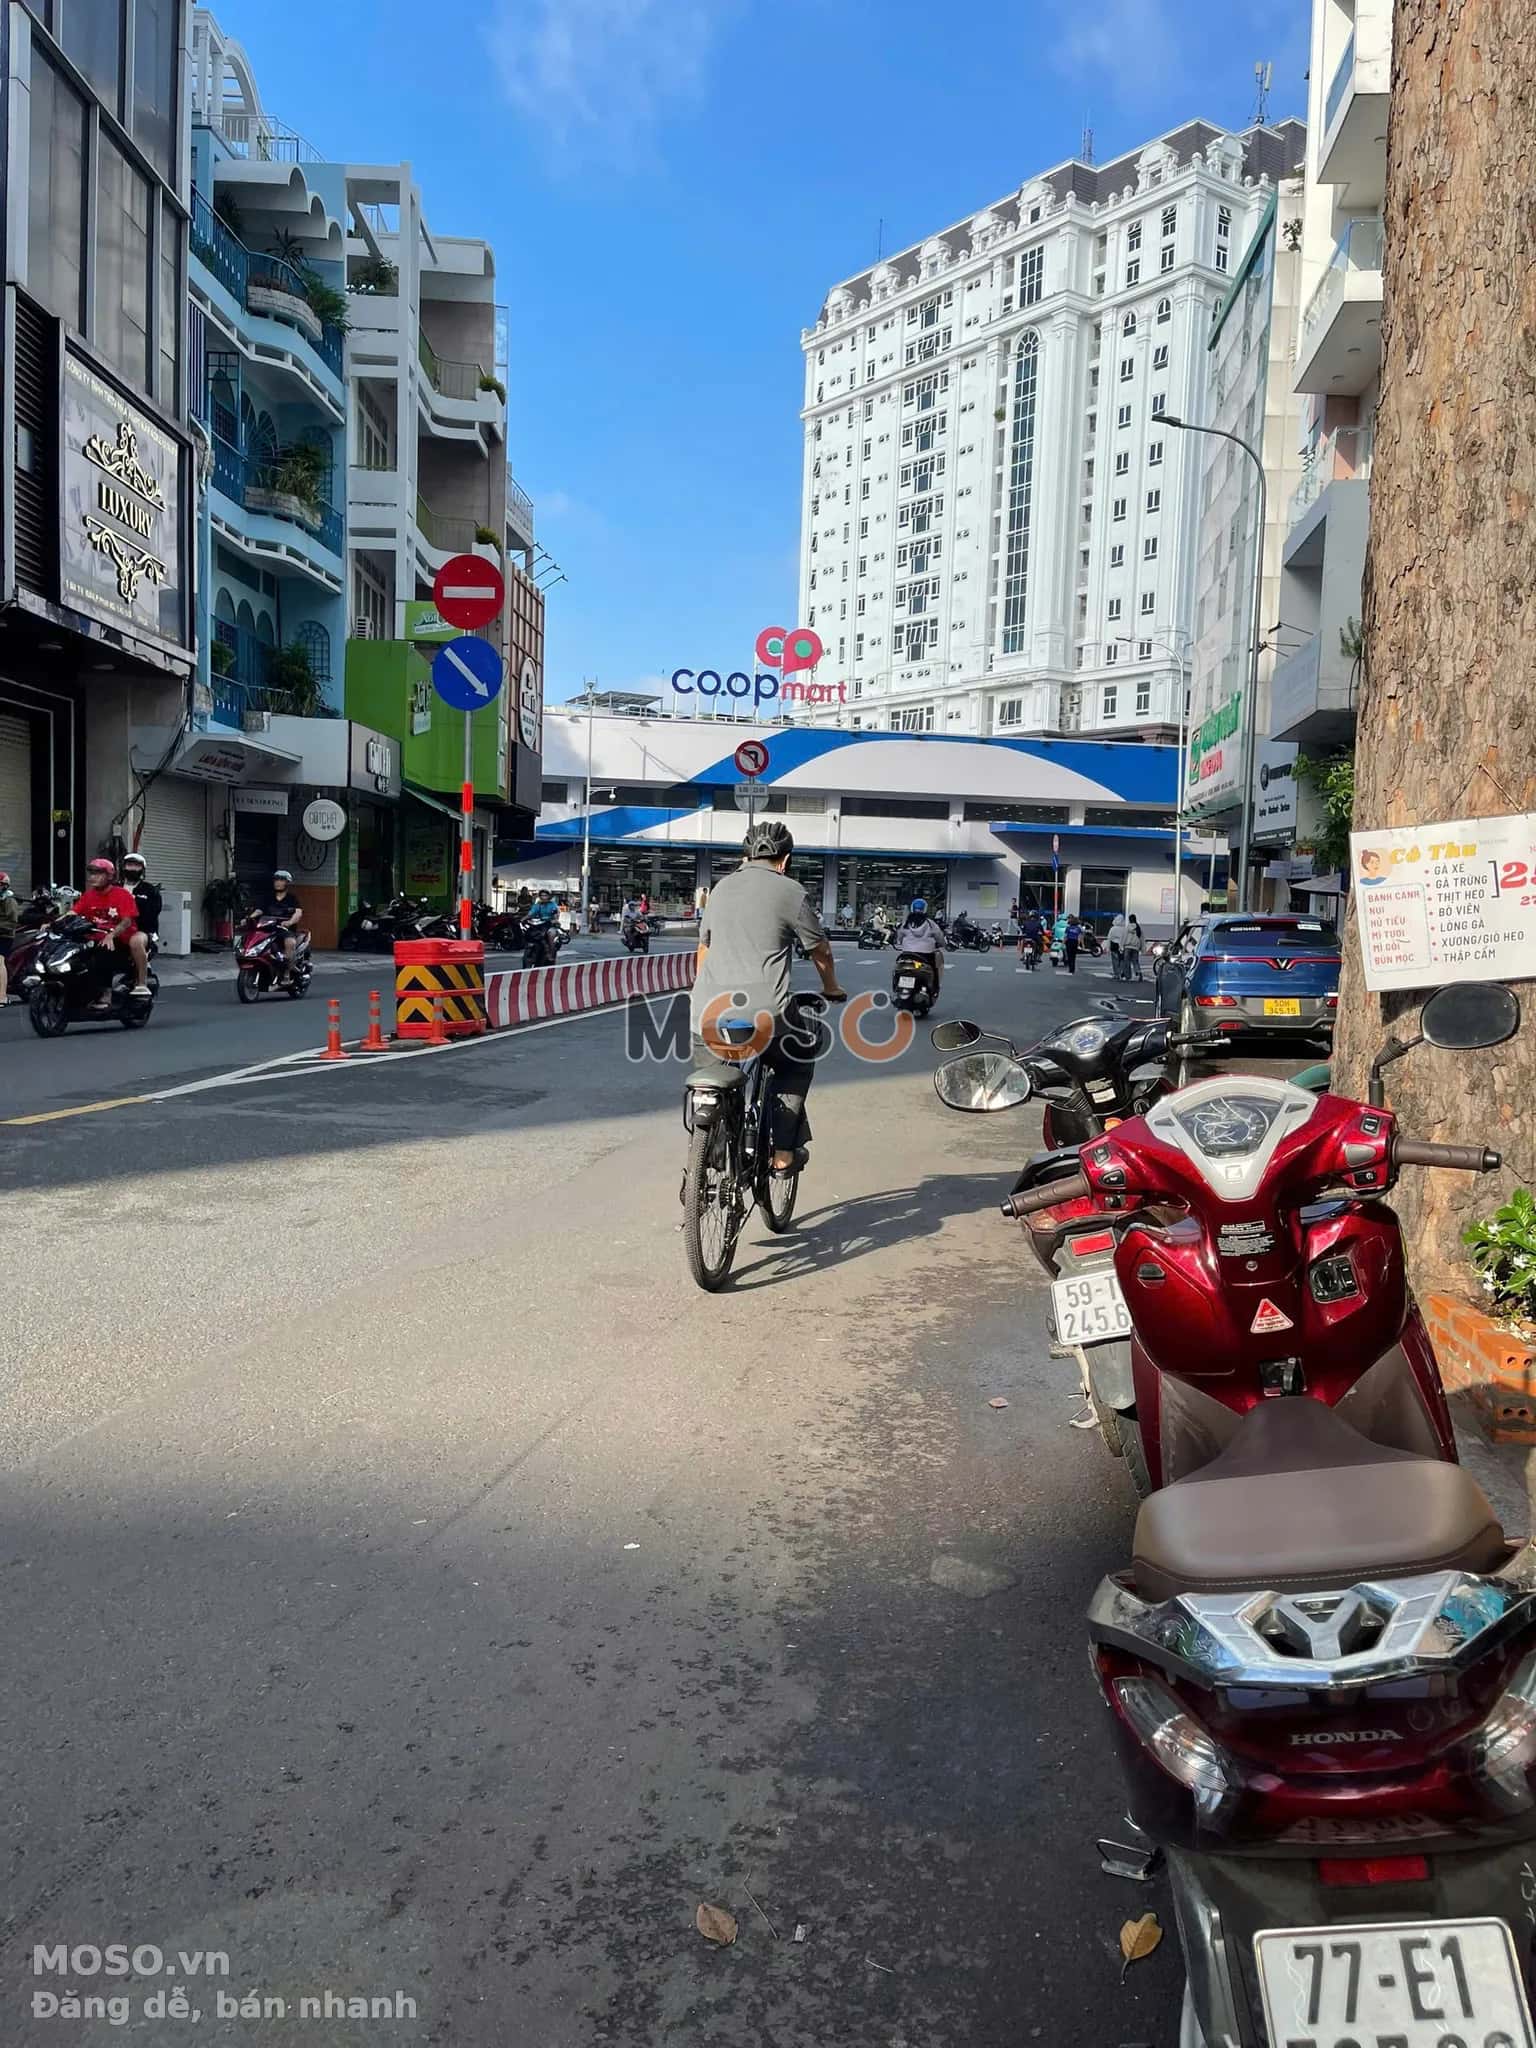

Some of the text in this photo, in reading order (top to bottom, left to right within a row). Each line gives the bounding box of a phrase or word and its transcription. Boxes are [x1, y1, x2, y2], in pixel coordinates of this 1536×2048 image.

[101, 483, 153, 538] LUXURY
[1500, 861, 1536, 888] 2
[1065, 1275, 1118, 1308] 59-T
[1064, 1303, 1130, 1339] 245.6
[1290, 1729, 1404, 1746] HONDA
[1293, 1935, 1474, 2025] 77-E1
